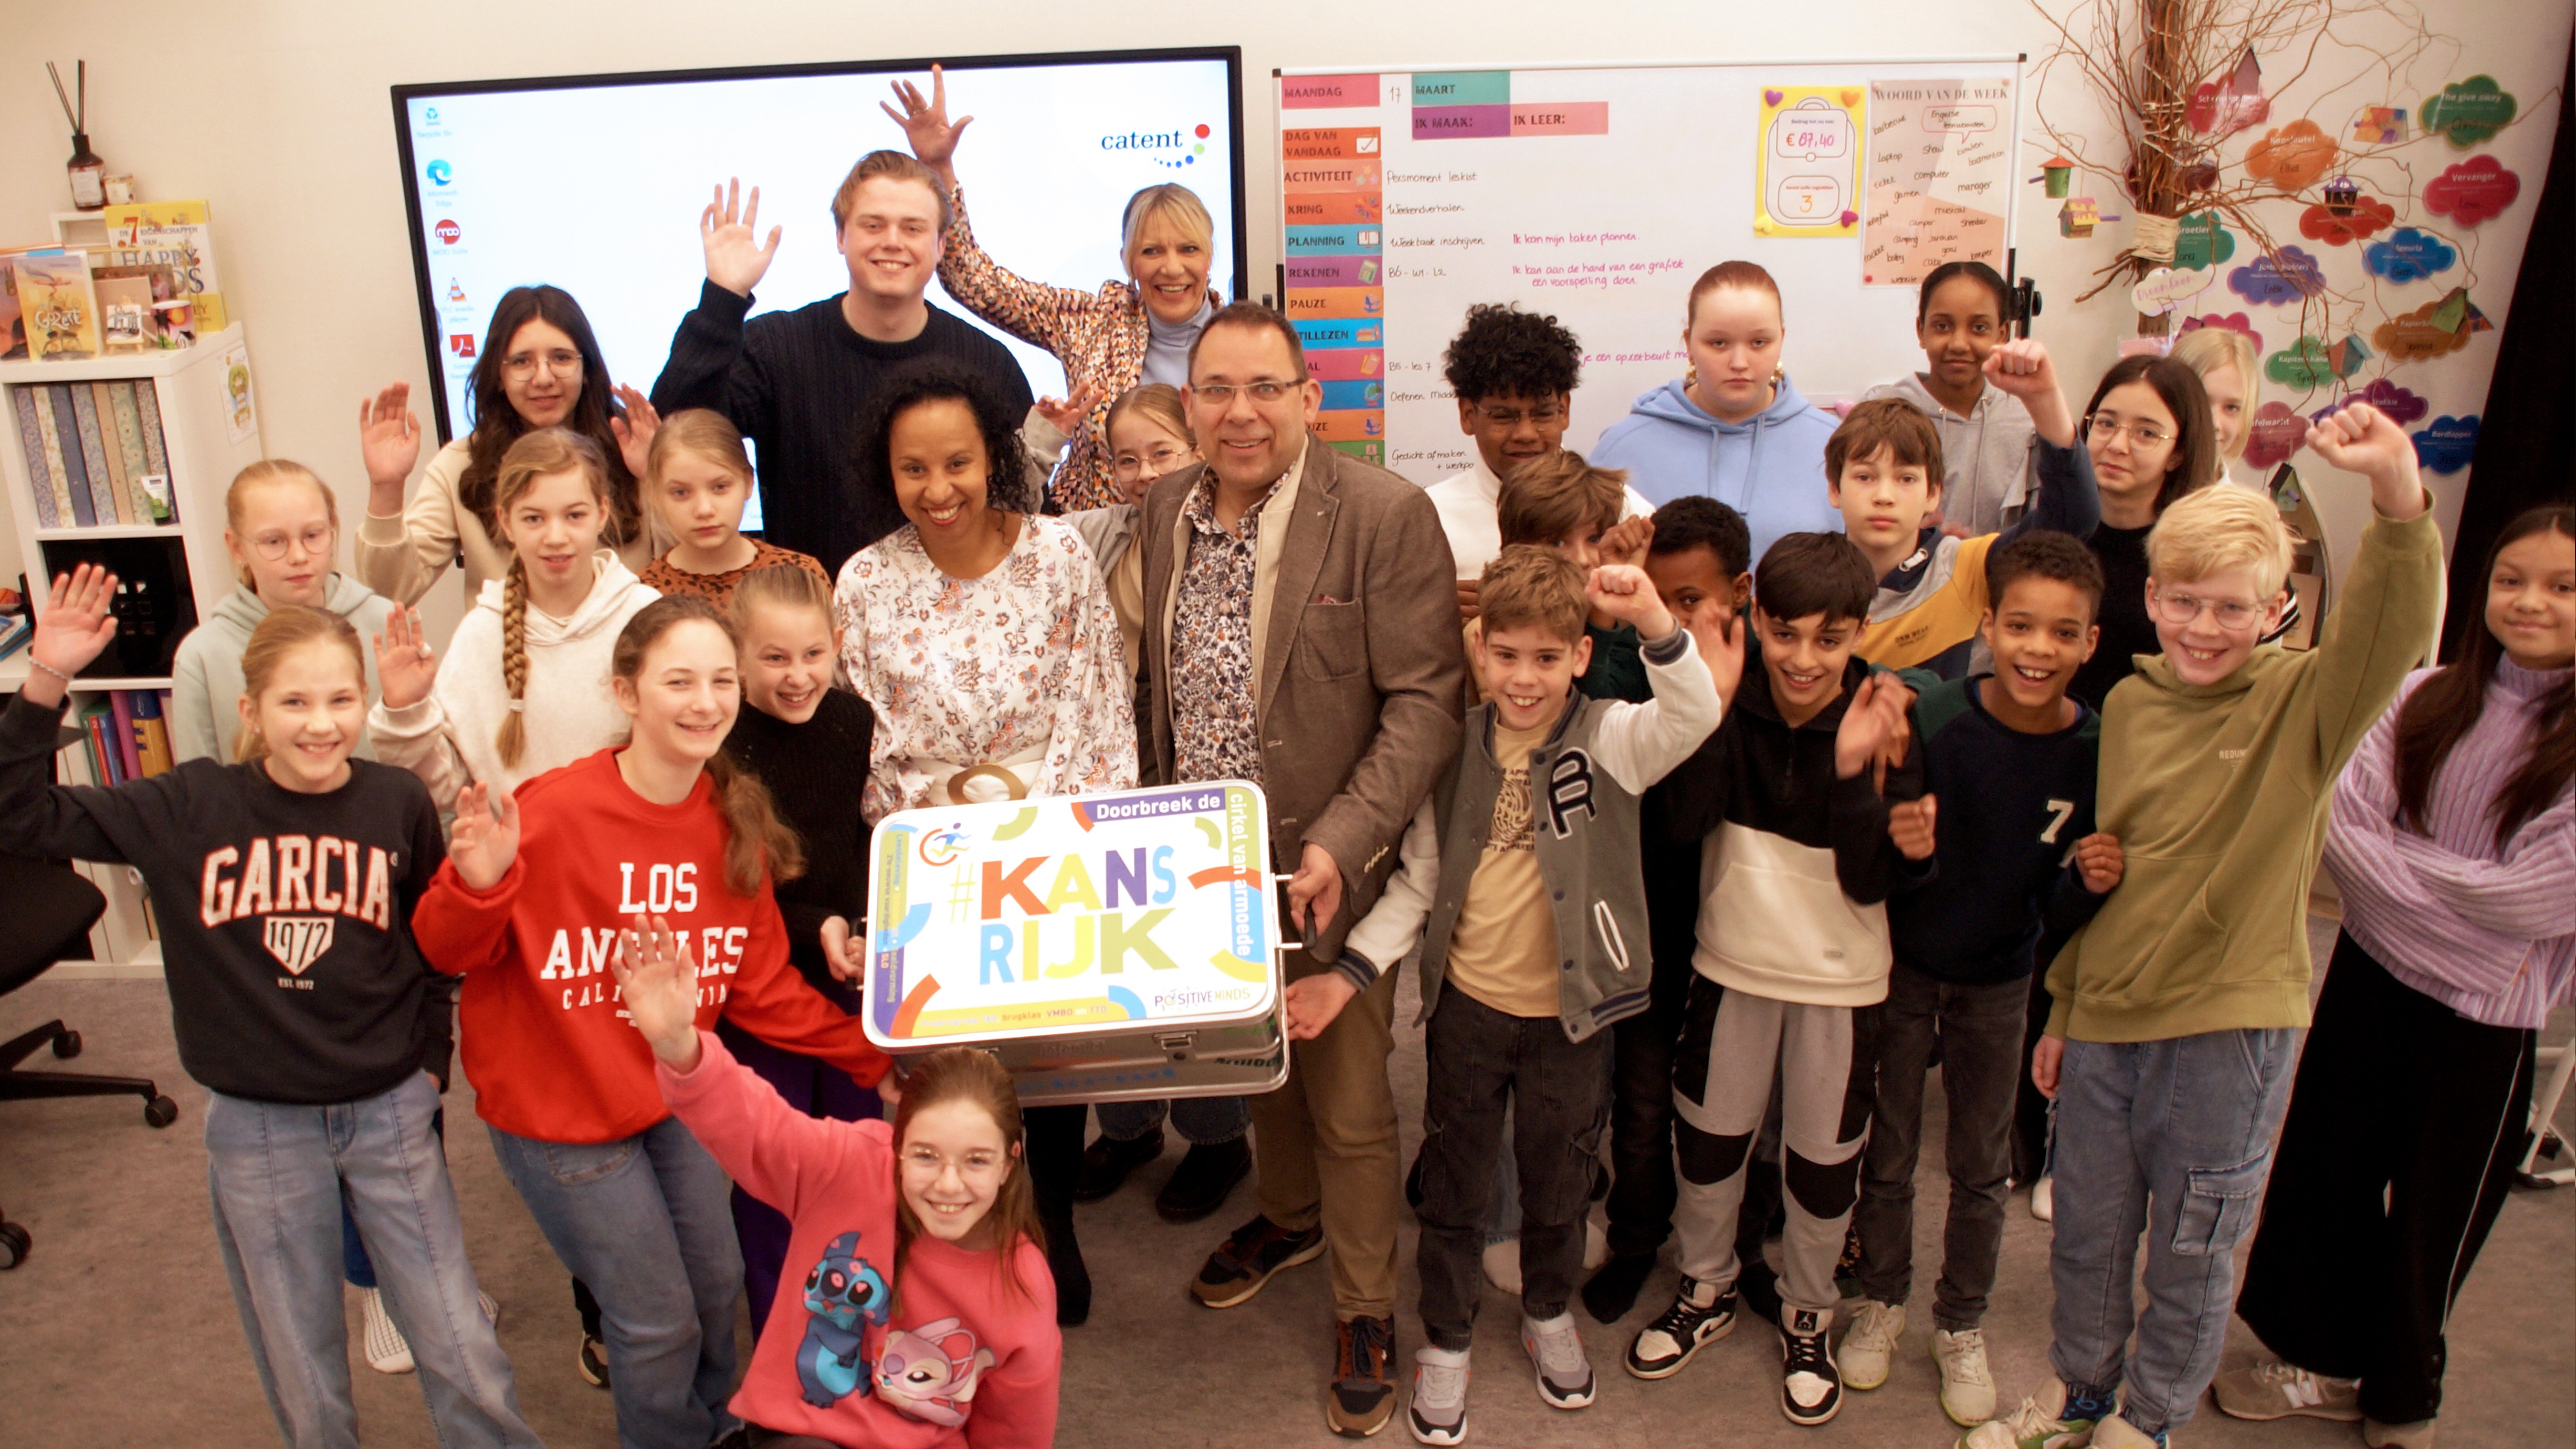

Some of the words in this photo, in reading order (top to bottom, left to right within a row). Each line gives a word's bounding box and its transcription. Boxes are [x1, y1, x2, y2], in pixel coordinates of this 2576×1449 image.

[1285, 87, 1342, 98] MAANDAG
[1389, 86, 1401, 103] 17
[1415, 85, 1456, 95] MAART
[1875, 89, 1922, 101] WOORD
[1926, 89, 1950, 100] VAN
[1954, 89, 1969, 99] DE
[1974, 88, 2007, 99] WEEK
[1415, 119, 1427, 129] IK
[1433, 118, 1473, 128] MAAK:
[1514, 116, 1525, 125] IK
[1531, 114, 1565, 125] LEER:
[1873, 115, 1907, 135] barbecue
[1101, 130, 1183, 150] catent
[1286, 132, 1310, 141] DAG
[1314, 131, 1337, 140] VAN
[1786, 133, 1795, 146] €
[1286, 147, 1341, 156] VANDAAG
[1284, 171, 1353, 182] ACTIVITEIT
[1448, 171, 1477, 182] leskist
[1913, 171, 1950, 181] computer
[1958, 181, 1992, 195] manager
[1288, 205, 1323, 214] KRING
[1800, 195, 1813, 213] 3
[123, 217, 139, 244] 7
[1288, 237, 1344, 247] PLANNING
[1513, 234, 1521, 244] Ik
[1524, 234, 1543, 244] kan
[1545, 234, 1565, 247] mijn
[1569, 233, 1597, 243] taken
[121, 248, 199, 267] HAPPY
[1289, 268, 1340, 278] REKENEN
[1512, 266, 1521, 275] Ik
[1525, 265, 1542, 275] kan
[1546, 266, 1564, 275] aan
[1568, 265, 1579, 274] de
[1582, 262, 1605, 273] hand
[1609, 263, 1625, 271] van
[1532, 278, 1548, 287] een
[1290, 299, 1327, 309] PAUZE
[1298, 330, 1349, 341] TILLEZEN
[1308, 363, 1321, 371] AL
[1308, 422, 1328, 432] UZE
[92, 720, 99, 729] 2
[1097, 796, 1193, 819] Doorbreek
[1198, 794, 1221, 809] de
[1230, 794, 1248, 842] cirkel
[2040, 799, 2075, 844] 7
[1233, 844, 1247, 875] van
[200, 834, 390, 932] GARCIA
[619, 862, 698, 914] LOS
[1234, 879, 1254, 957] armoede
[269, 922, 329, 970] 1972
[980, 908, 1180, 985] RIJK
[563, 983, 727, 1010] CALINIA
[1155, 991, 1213, 1007] POSITIVE
[1215, 988, 1250, 1001] MINDS
[1047, 1008, 1073, 1017] VMBO
[1090, 1005, 1107, 1014] TTO
